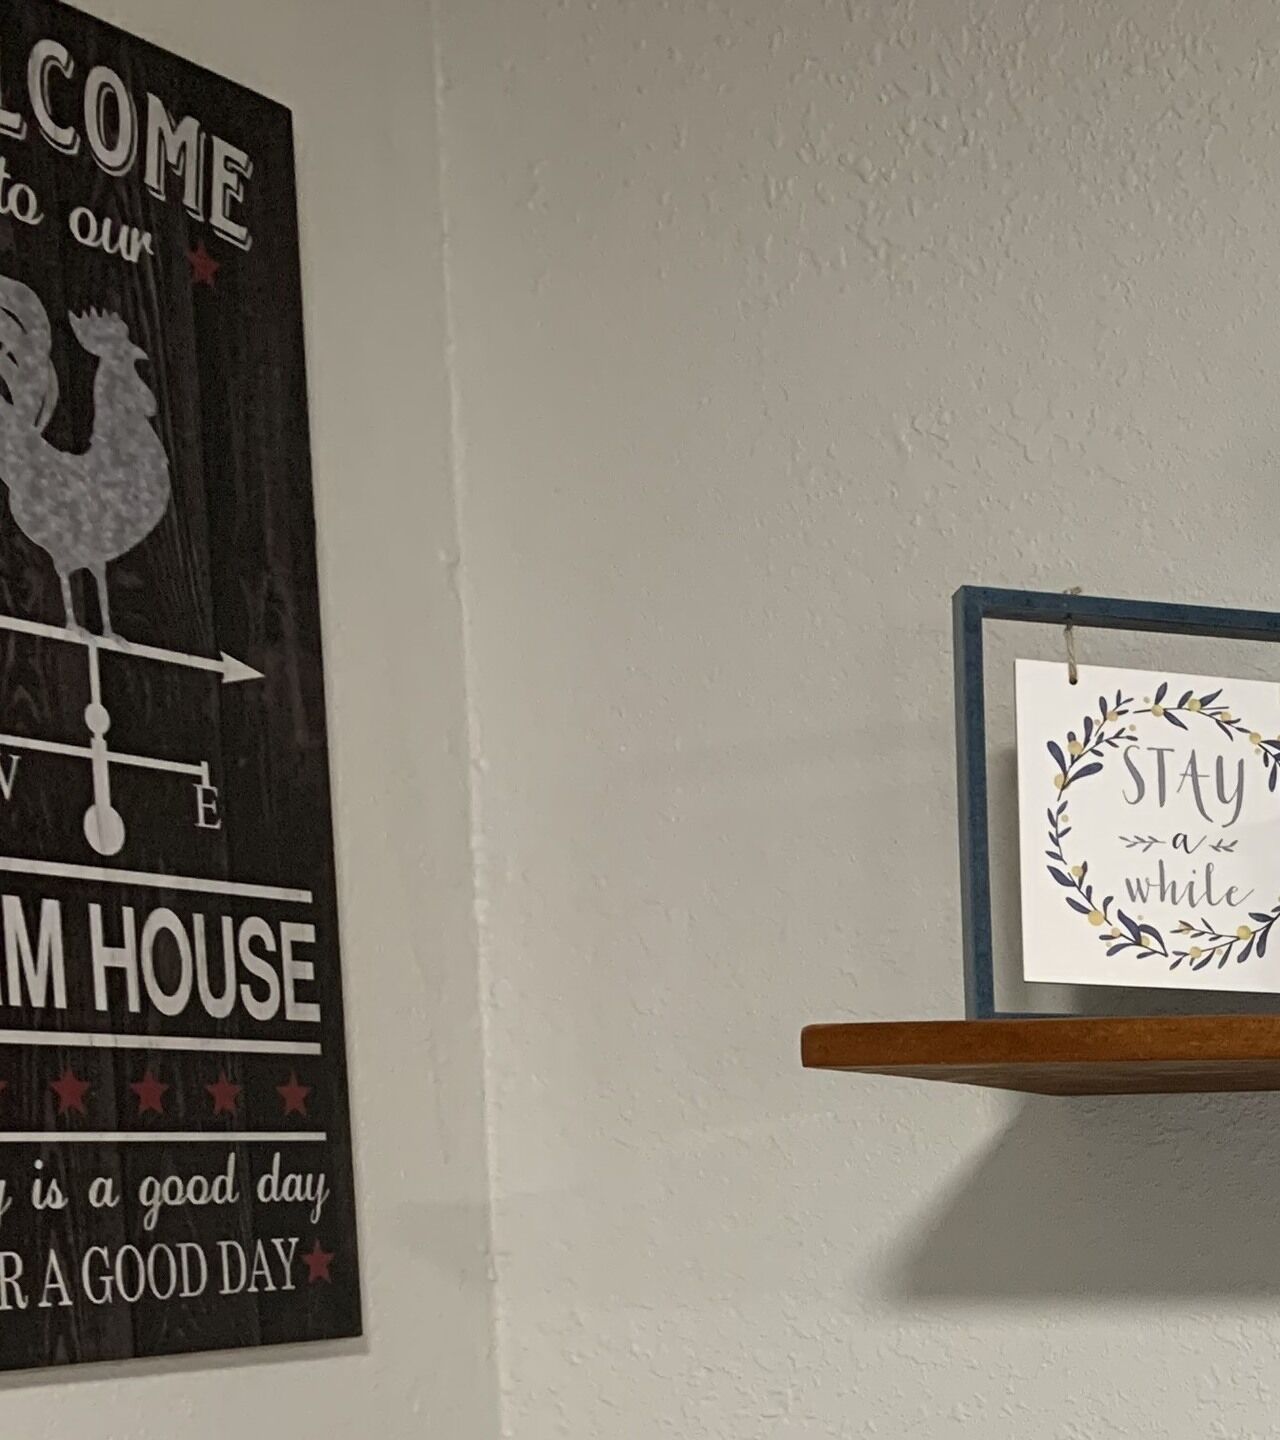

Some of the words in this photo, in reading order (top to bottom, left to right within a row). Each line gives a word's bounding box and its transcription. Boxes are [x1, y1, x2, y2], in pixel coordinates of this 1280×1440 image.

[0, 38, 253, 251] COME
[69, 206, 154, 263] our
[193, 783, 222, 830] E
[1121, 744, 1246, 828] STAY
[1172, 832, 1207, 855] a
[1125, 859, 1254, 908] while
[0, 894, 67, 1009] M
[88, 902, 321, 1022] HOUSE
[31, 1158, 69, 1210] is
[88, 1176, 121, 1208] a
[139, 1151, 240, 1231] good
[256, 1151, 331, 1225] day
[38, 1248, 74, 1308] A
[82, 1242, 208, 1304] GOOD
[216, 1236, 300, 1295] DAY
